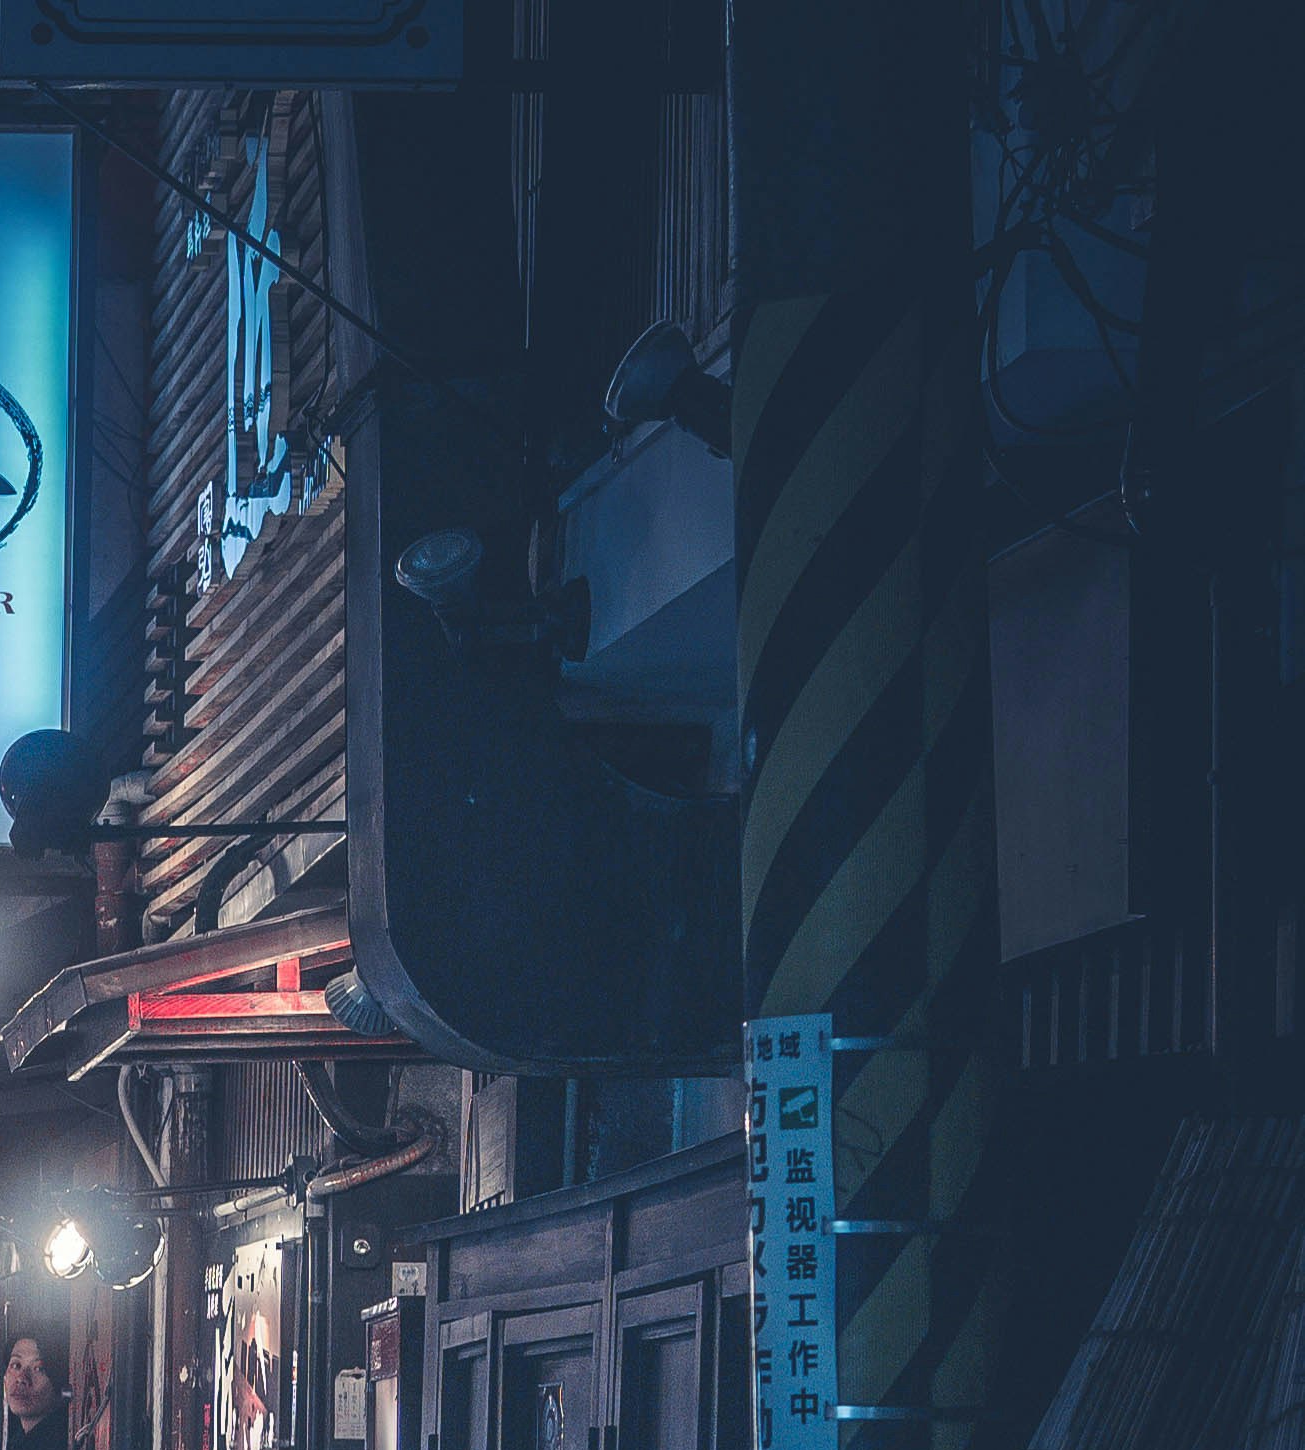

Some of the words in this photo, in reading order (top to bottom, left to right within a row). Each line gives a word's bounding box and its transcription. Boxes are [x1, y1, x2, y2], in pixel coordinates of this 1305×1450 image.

[785, 1147, 819, 1425] 监视器工作中
